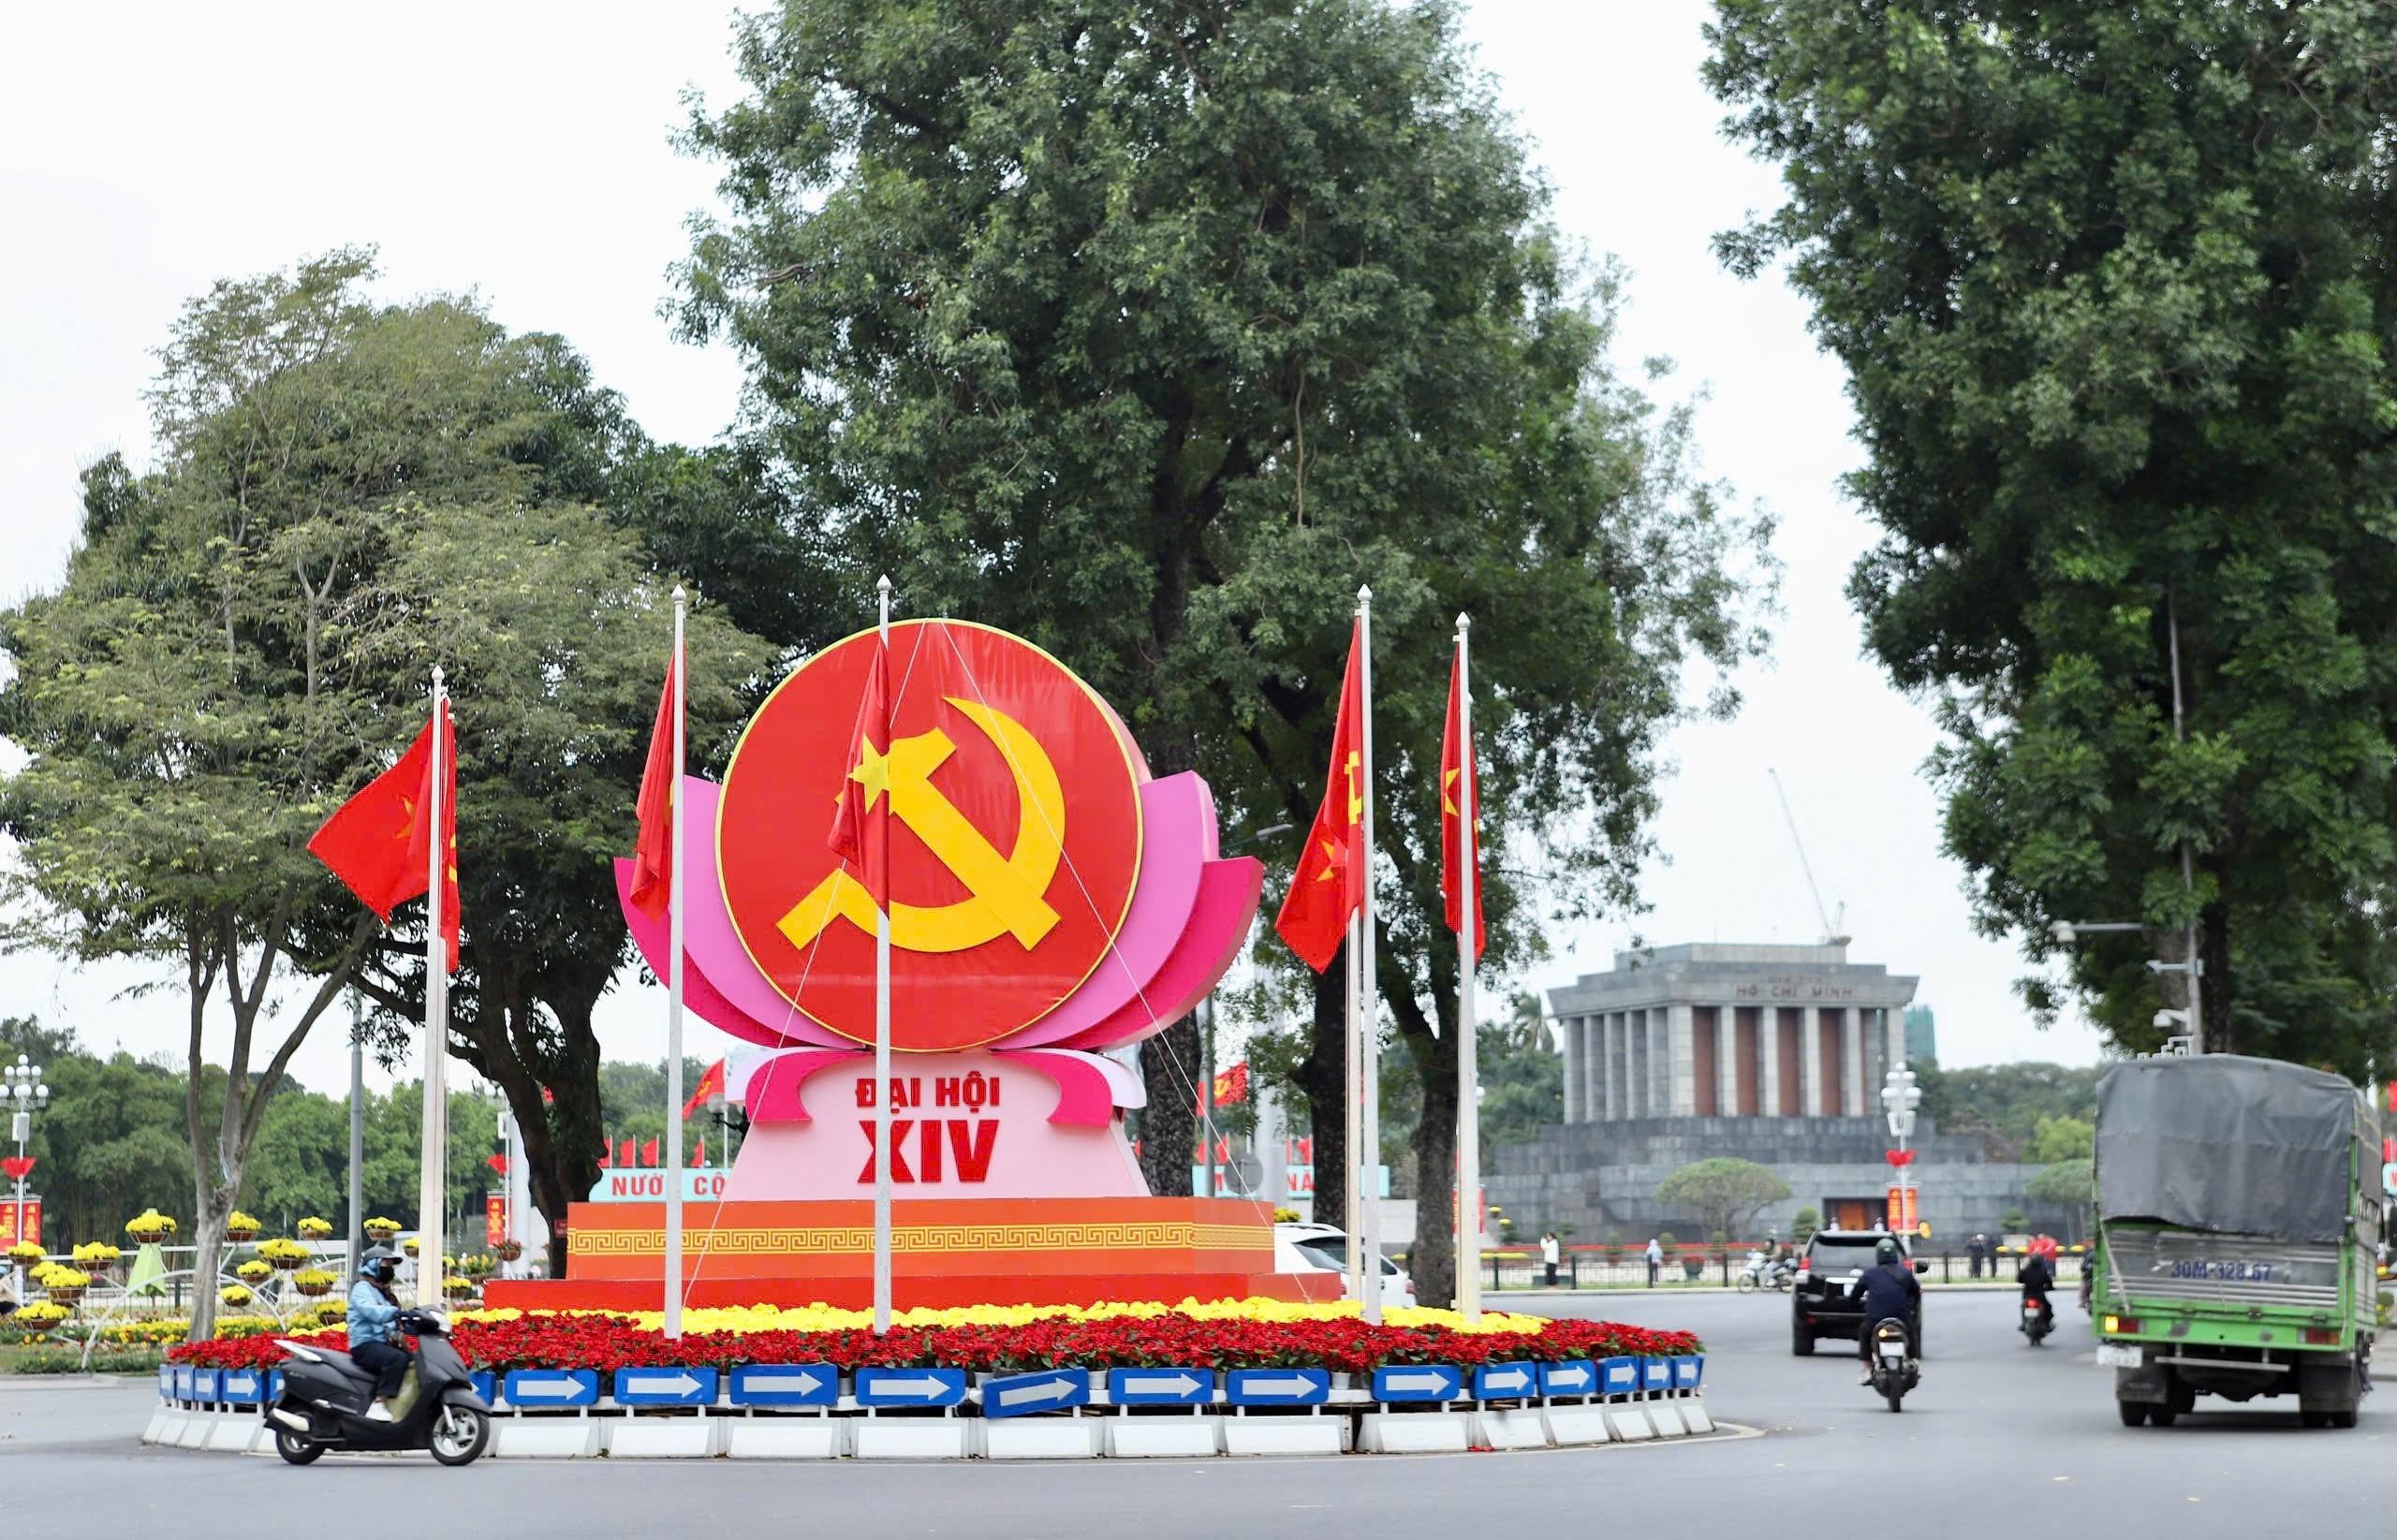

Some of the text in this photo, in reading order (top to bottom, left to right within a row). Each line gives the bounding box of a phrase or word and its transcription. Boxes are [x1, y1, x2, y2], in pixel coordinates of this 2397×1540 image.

[855, 1070, 1000, 1114] ĐẠI HỘI
[857, 1120, 1000, 1183] XIV
[694, 1171, 726, 1199] CỘ
